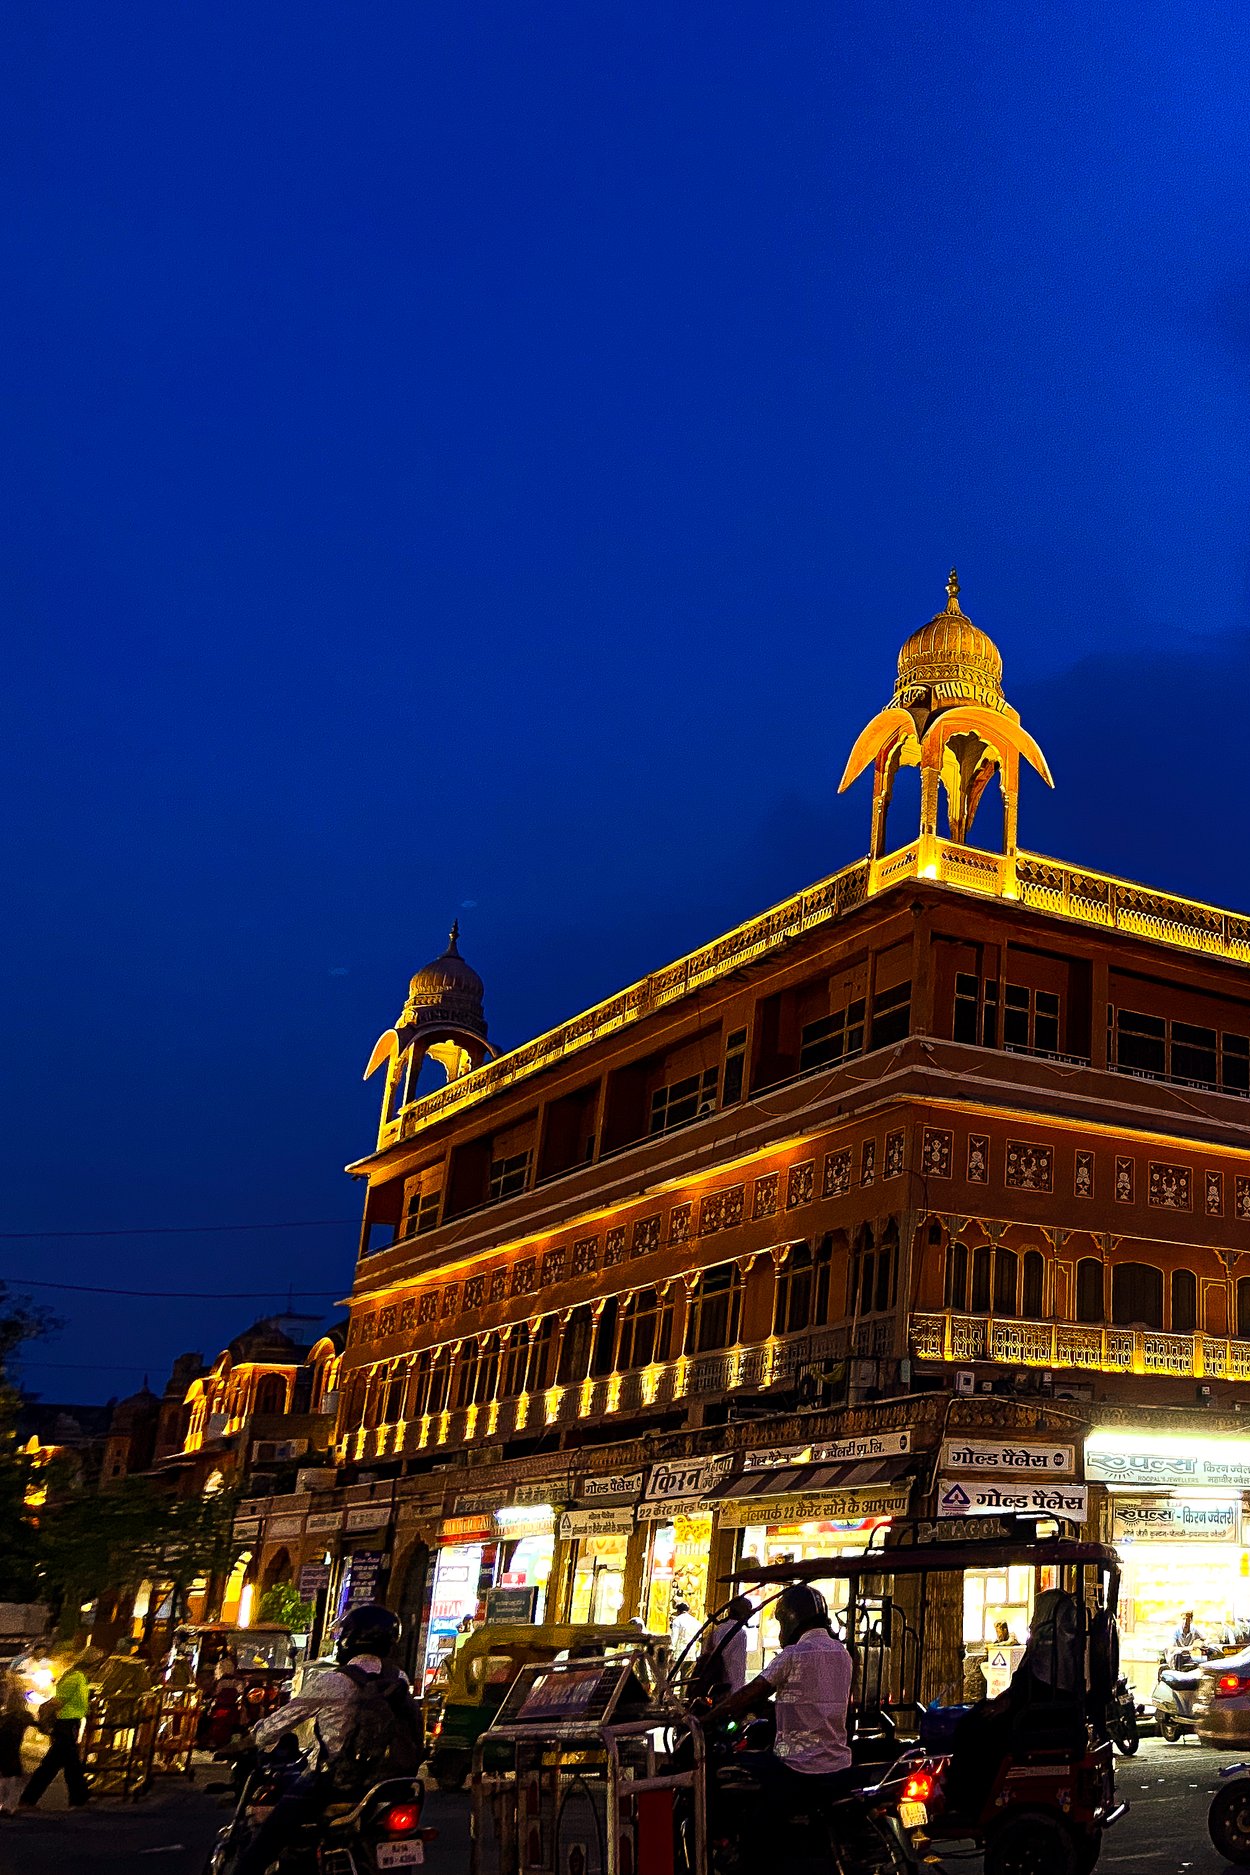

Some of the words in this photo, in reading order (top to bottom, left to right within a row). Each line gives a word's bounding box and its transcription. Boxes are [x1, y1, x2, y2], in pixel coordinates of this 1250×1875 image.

[935, 681, 974, 700] HIND
[952, 1447, 999, 1465] गोल्ड
[1001, 1448, 1049, 1467] पैलेस
[1203, 1461, 1229, 1474] किरन
[586, 1480, 608, 1494] गोल्ड
[610, 1476, 634, 1492] पैलेस
[649, 1466, 704, 1494] किरन
[783, 1507, 795, 1519] 22
[795, 1502, 822, 1517] कैरेट
[823, 1500, 846, 1516] सोने
[847, 1497, 859, 1513] के
[861, 1497, 906, 1515] आभूषण
[976, 1488, 1029, 1508] गोल्ड
[1032, 1490, 1084, 1510] पैलेस
[639, 1508, 651, 1518] 22
[1182, 1506, 1206, 1524] किरन
[434, 1600, 462, 1616] TITAN
